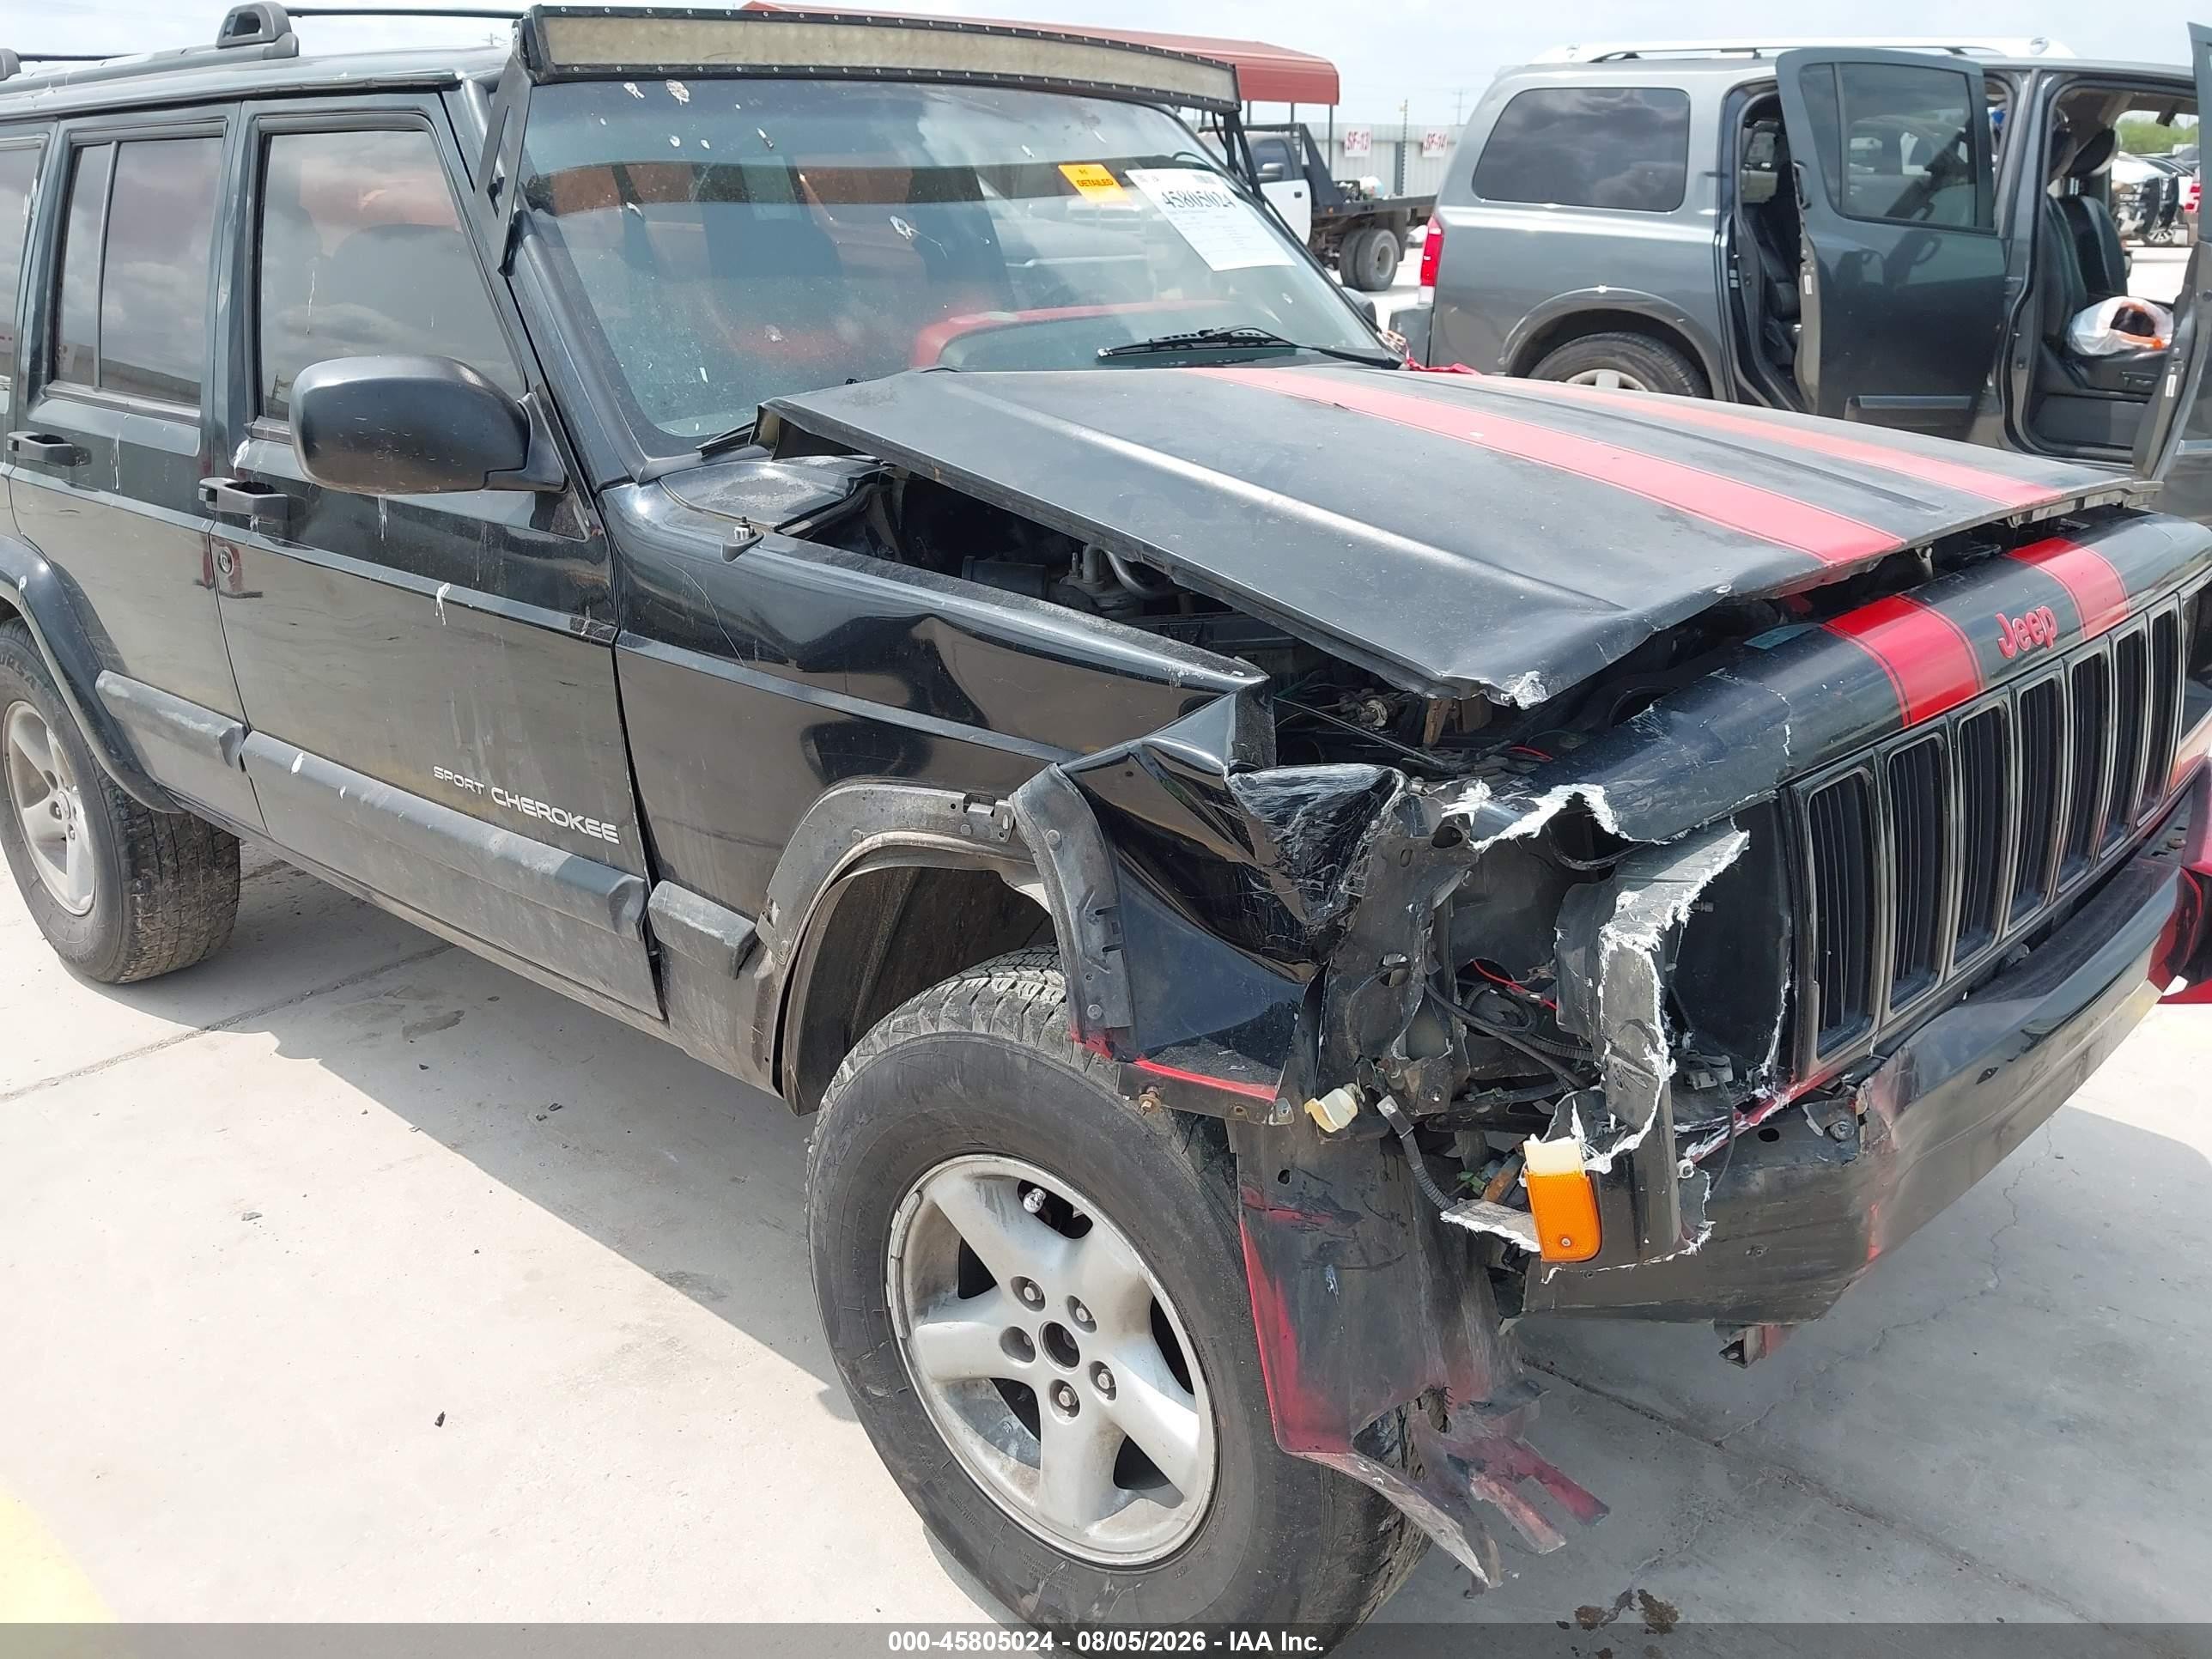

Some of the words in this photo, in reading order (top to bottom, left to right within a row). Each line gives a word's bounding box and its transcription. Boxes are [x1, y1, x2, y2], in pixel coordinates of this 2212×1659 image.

[1076, 178, 1115, 187] DETAILED
[1161, 190, 1237, 210] 45805024
[1994, 605, 2058, 659] Jeep
[433, 765, 485, 795] SPORT
[490, 787, 621, 845] CHEROKEE
